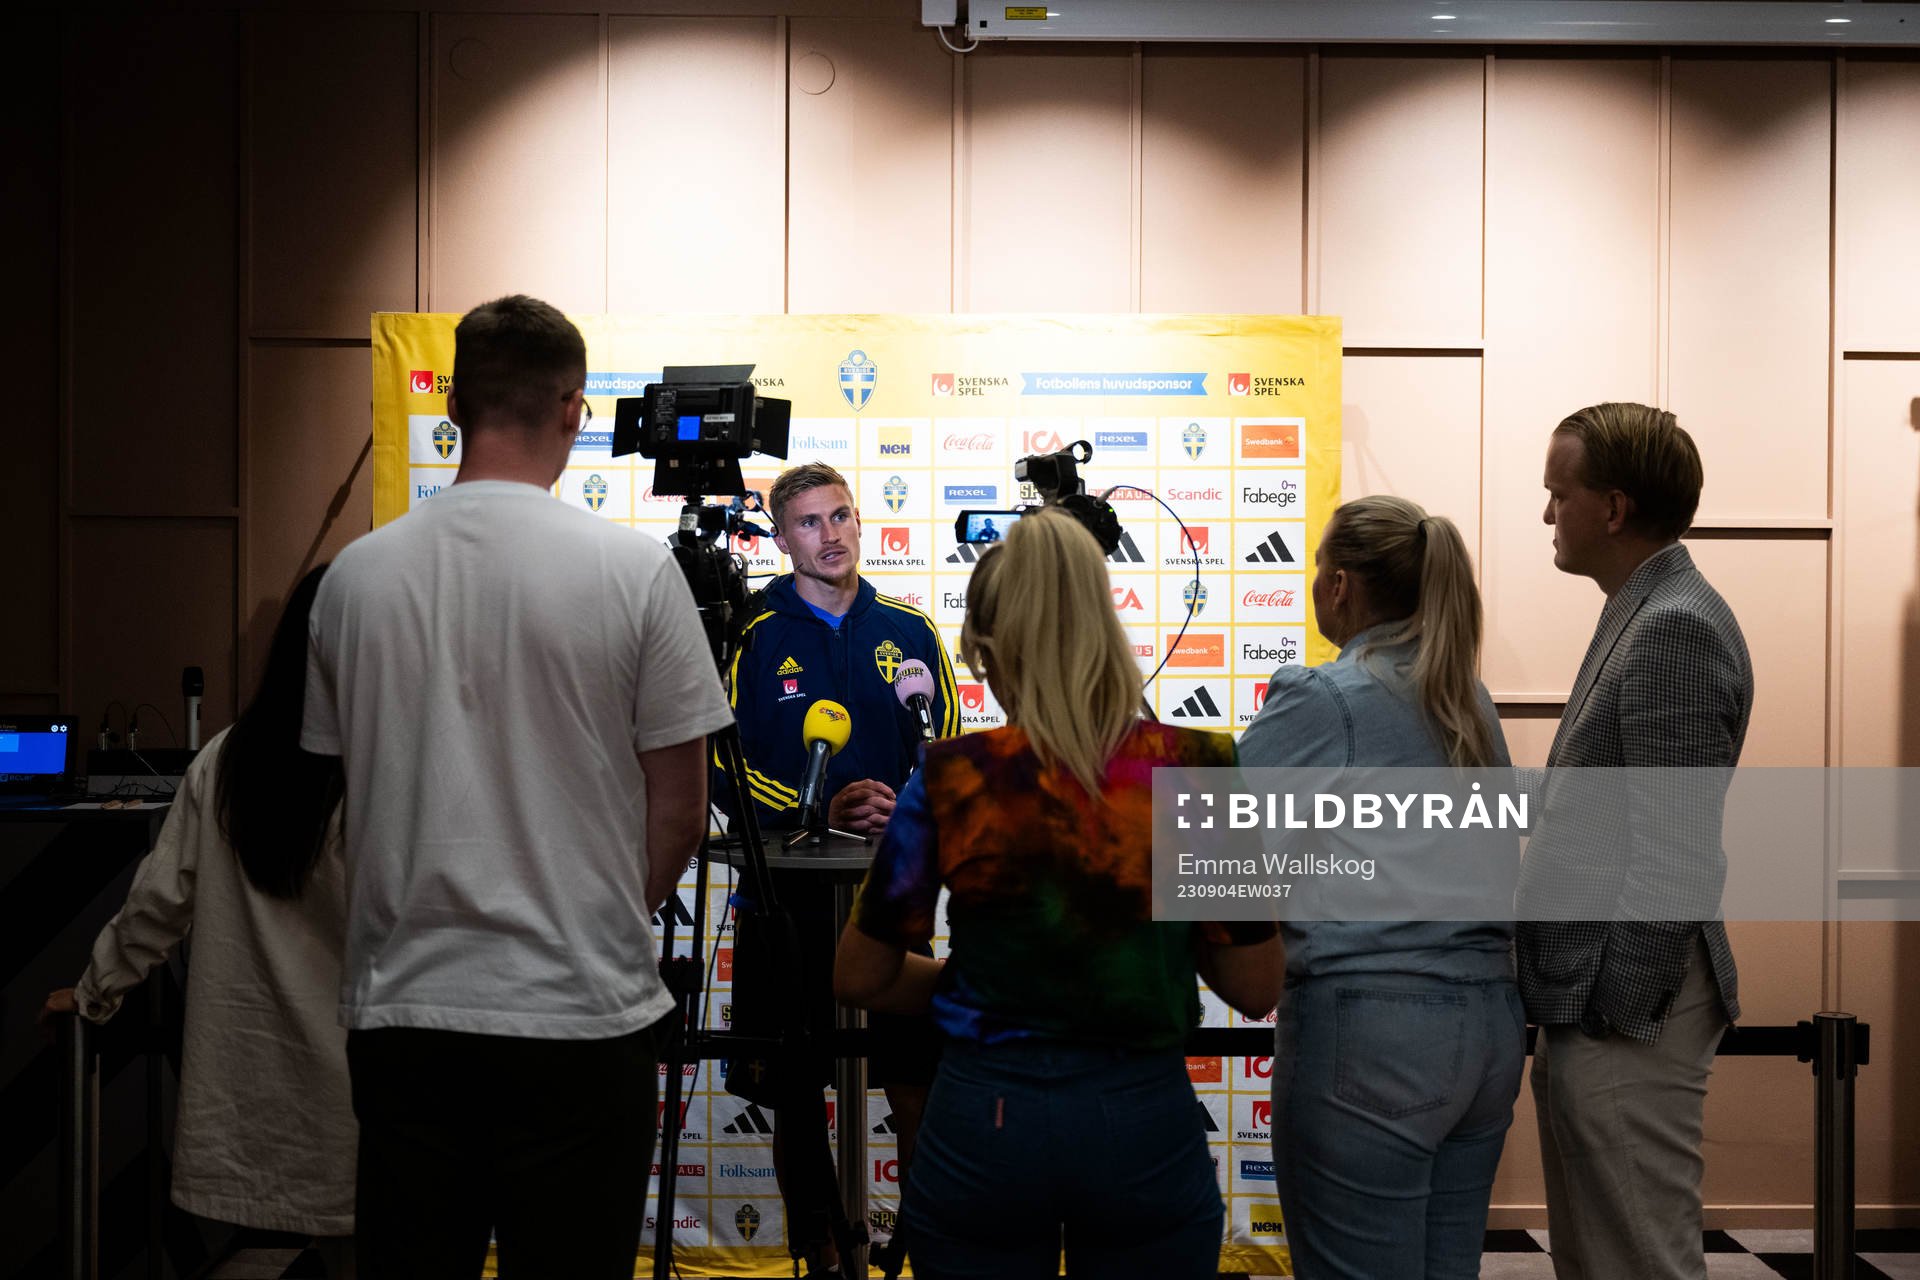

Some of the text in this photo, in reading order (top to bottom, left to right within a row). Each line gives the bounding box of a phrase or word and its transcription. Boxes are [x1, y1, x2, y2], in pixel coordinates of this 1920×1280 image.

[958, 377, 1009, 386] SVENSKA
[1036, 378, 1193, 392] Fotbollens huvudsponsor
[1254, 377, 1305, 386] SVENSKA
[958, 387, 984, 396] SPEL
[1254, 387, 1280, 396] SPEL
[792, 436, 848, 450] Folksam
[1023, 430, 1065, 453] ICA
[1245, 437, 1284, 446] Swedbank
[1168, 488, 1223, 501] Scandic
[1243, 488, 1296, 507] Fabege
[1243, 644, 1296, 663] Fabege
[776, 666, 804, 676] adidas
[720, 1164, 776, 1177] Folksam
